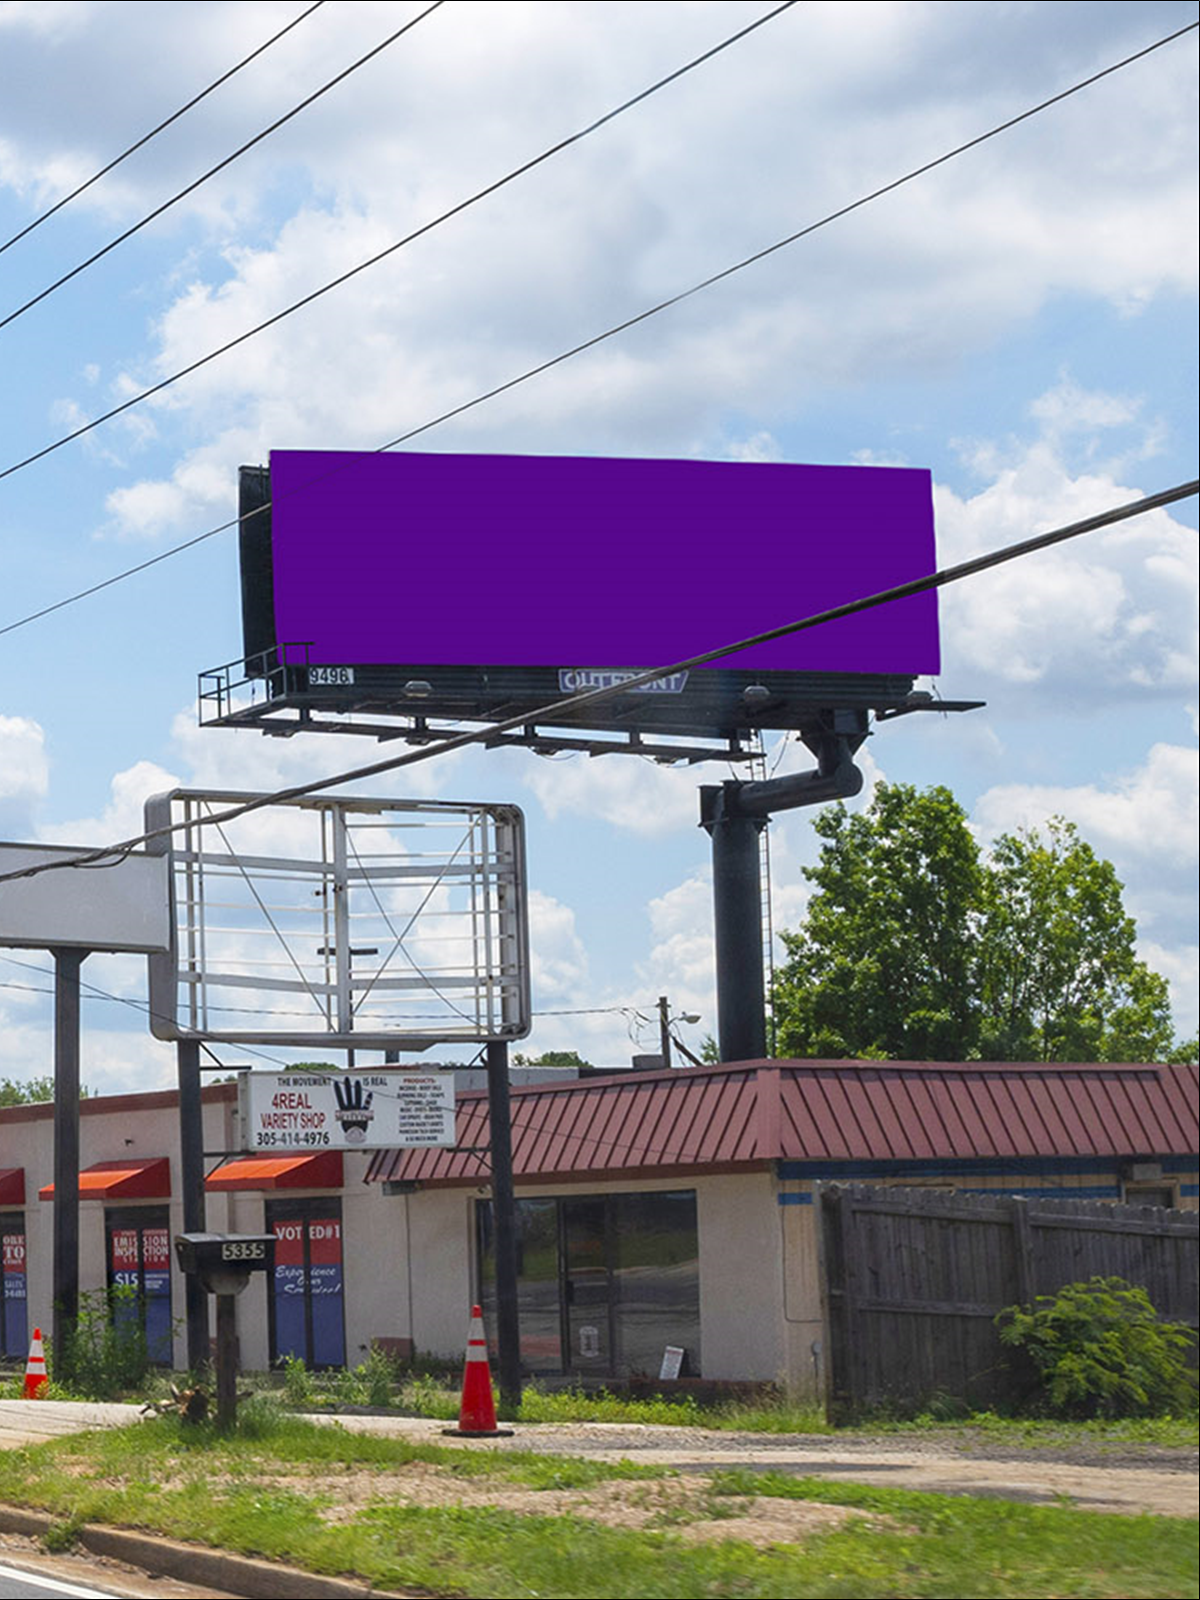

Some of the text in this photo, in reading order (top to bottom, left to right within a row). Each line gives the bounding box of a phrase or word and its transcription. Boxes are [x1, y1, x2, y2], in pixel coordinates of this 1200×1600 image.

[310, 667, 349, 684] 9496
[277, 1077, 388, 1087] THE MOVEMENT IS REAL
[272, 1093, 312, 1109] 4REAL
[261, 1113, 300, 1129] VARIETY
[301, 1112, 327, 1129] SHOP
[257, 1132, 330, 1146] 305-414-4976
[224, 1243, 264, 1259] 5355
